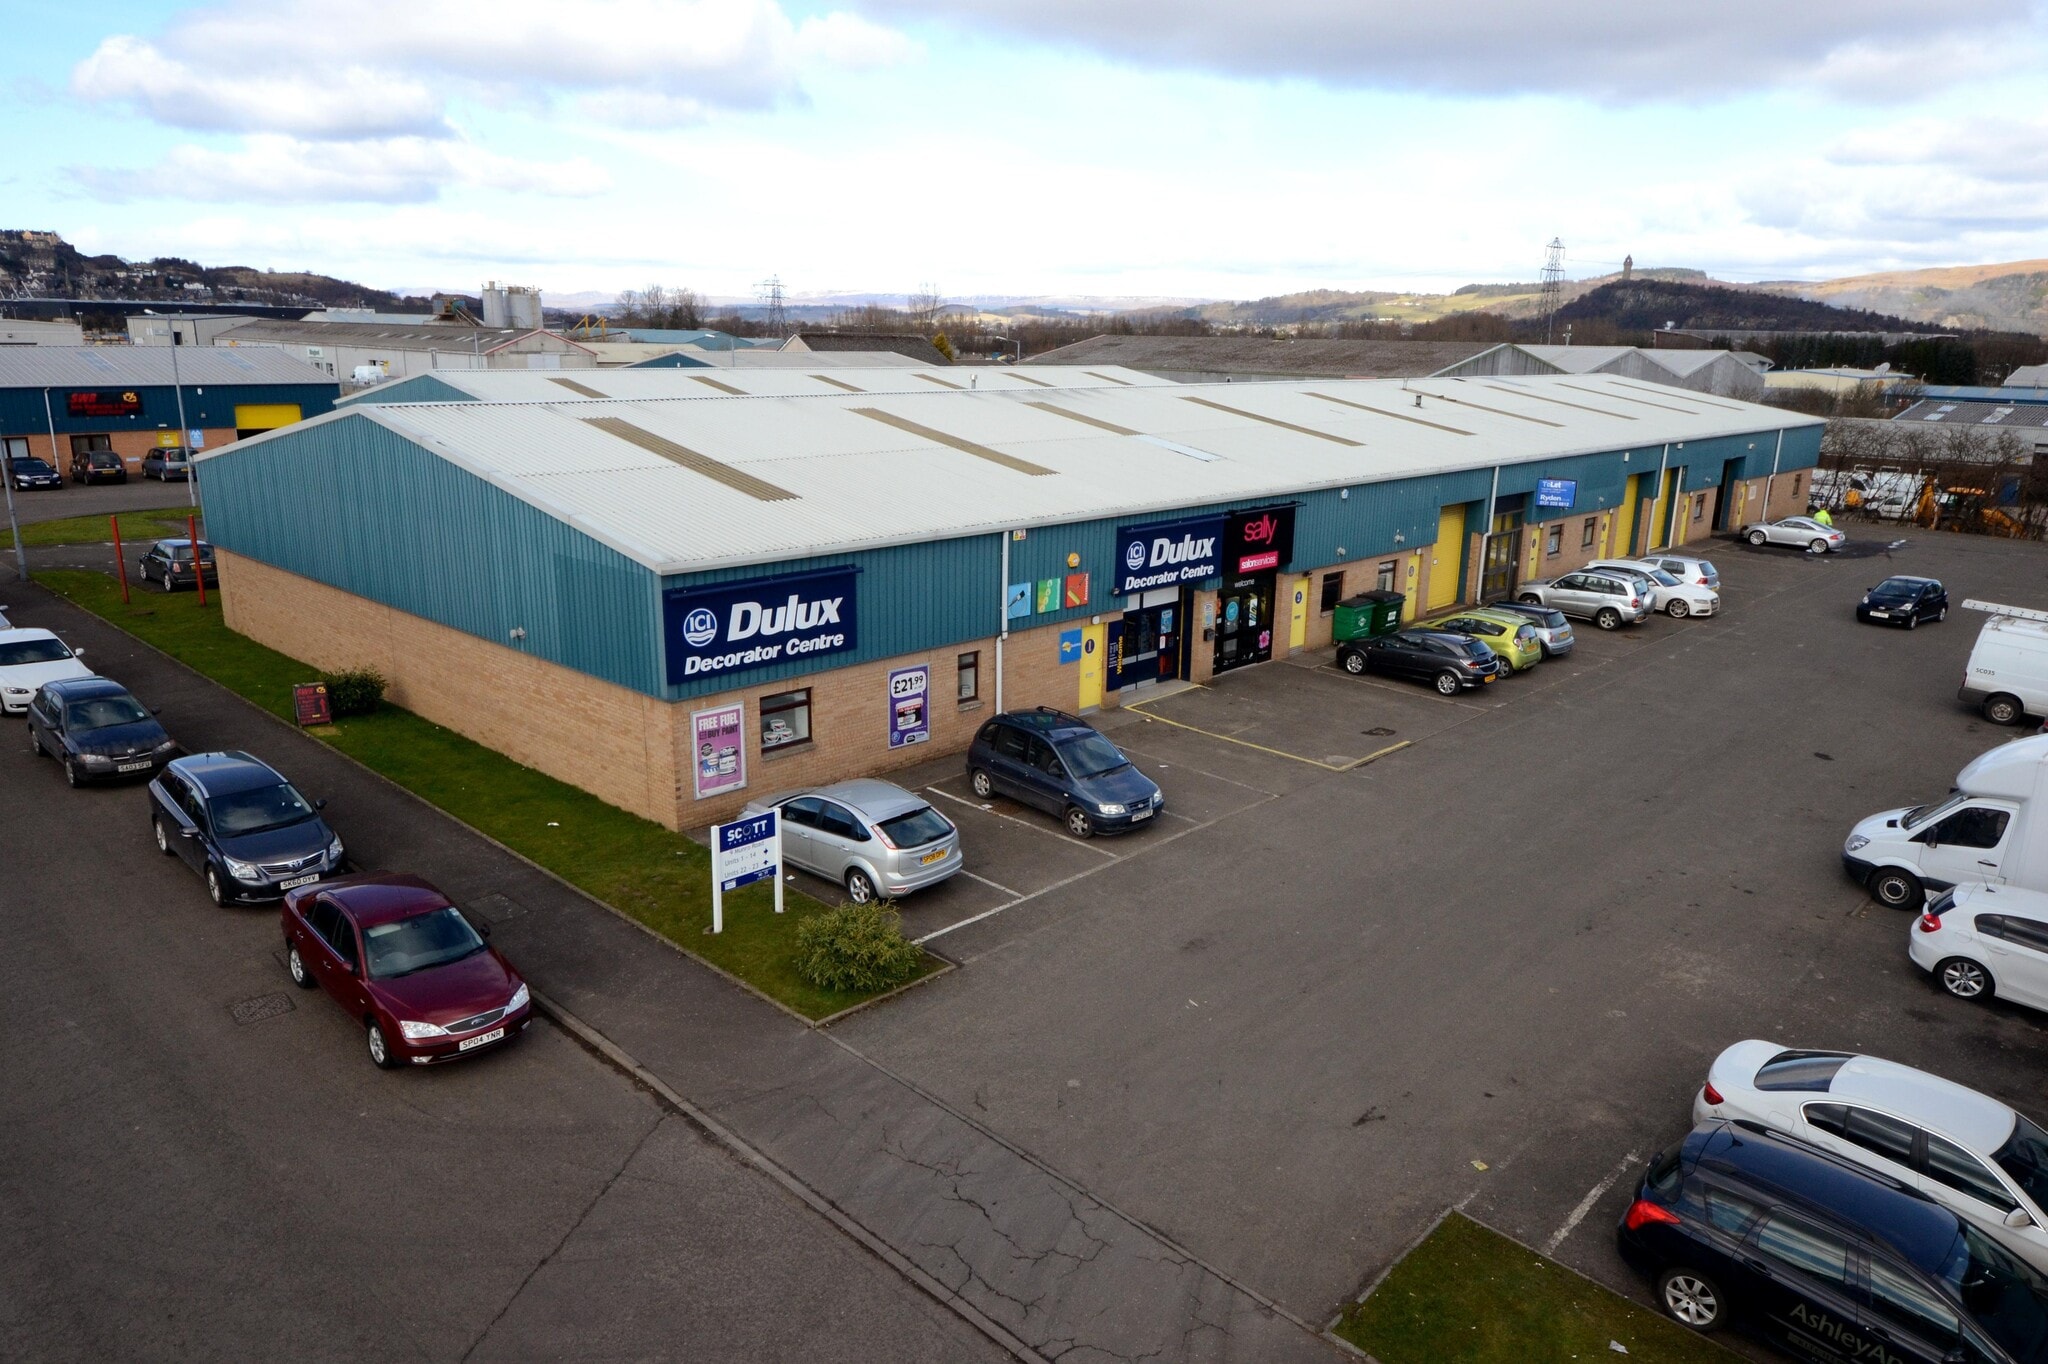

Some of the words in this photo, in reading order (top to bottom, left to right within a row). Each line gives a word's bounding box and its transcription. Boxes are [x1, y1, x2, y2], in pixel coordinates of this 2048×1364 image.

[1540, 494, 1562, 502] Ryden
[1244, 514, 1277, 544] sally
[1130, 546, 1142, 559] ICI
[1149, 533, 1216, 568] Dulux
[1124, 570, 1179, 591] Decorator
[1180, 564, 1214, 580] Centre
[1234, 579, 1255, 588] welcome
[689, 614, 711, 633] ICI
[727, 594, 843, 642] Dulux
[684, 644, 782, 675] Decorator
[785, 633, 844, 655] Centre
[698, 716, 718, 731] FREE
[719, 712, 739, 727] FUEL
[707, 729, 720, 739] BUY
[721, 724, 738, 736] PAINT
[727, 819, 768, 842] SCOTT
[724, 858, 739, 866] Units
[724, 870, 739, 878] Units
[462, 1034, 484, 1049] SP04
[486, 1030, 501, 1041] YNR
